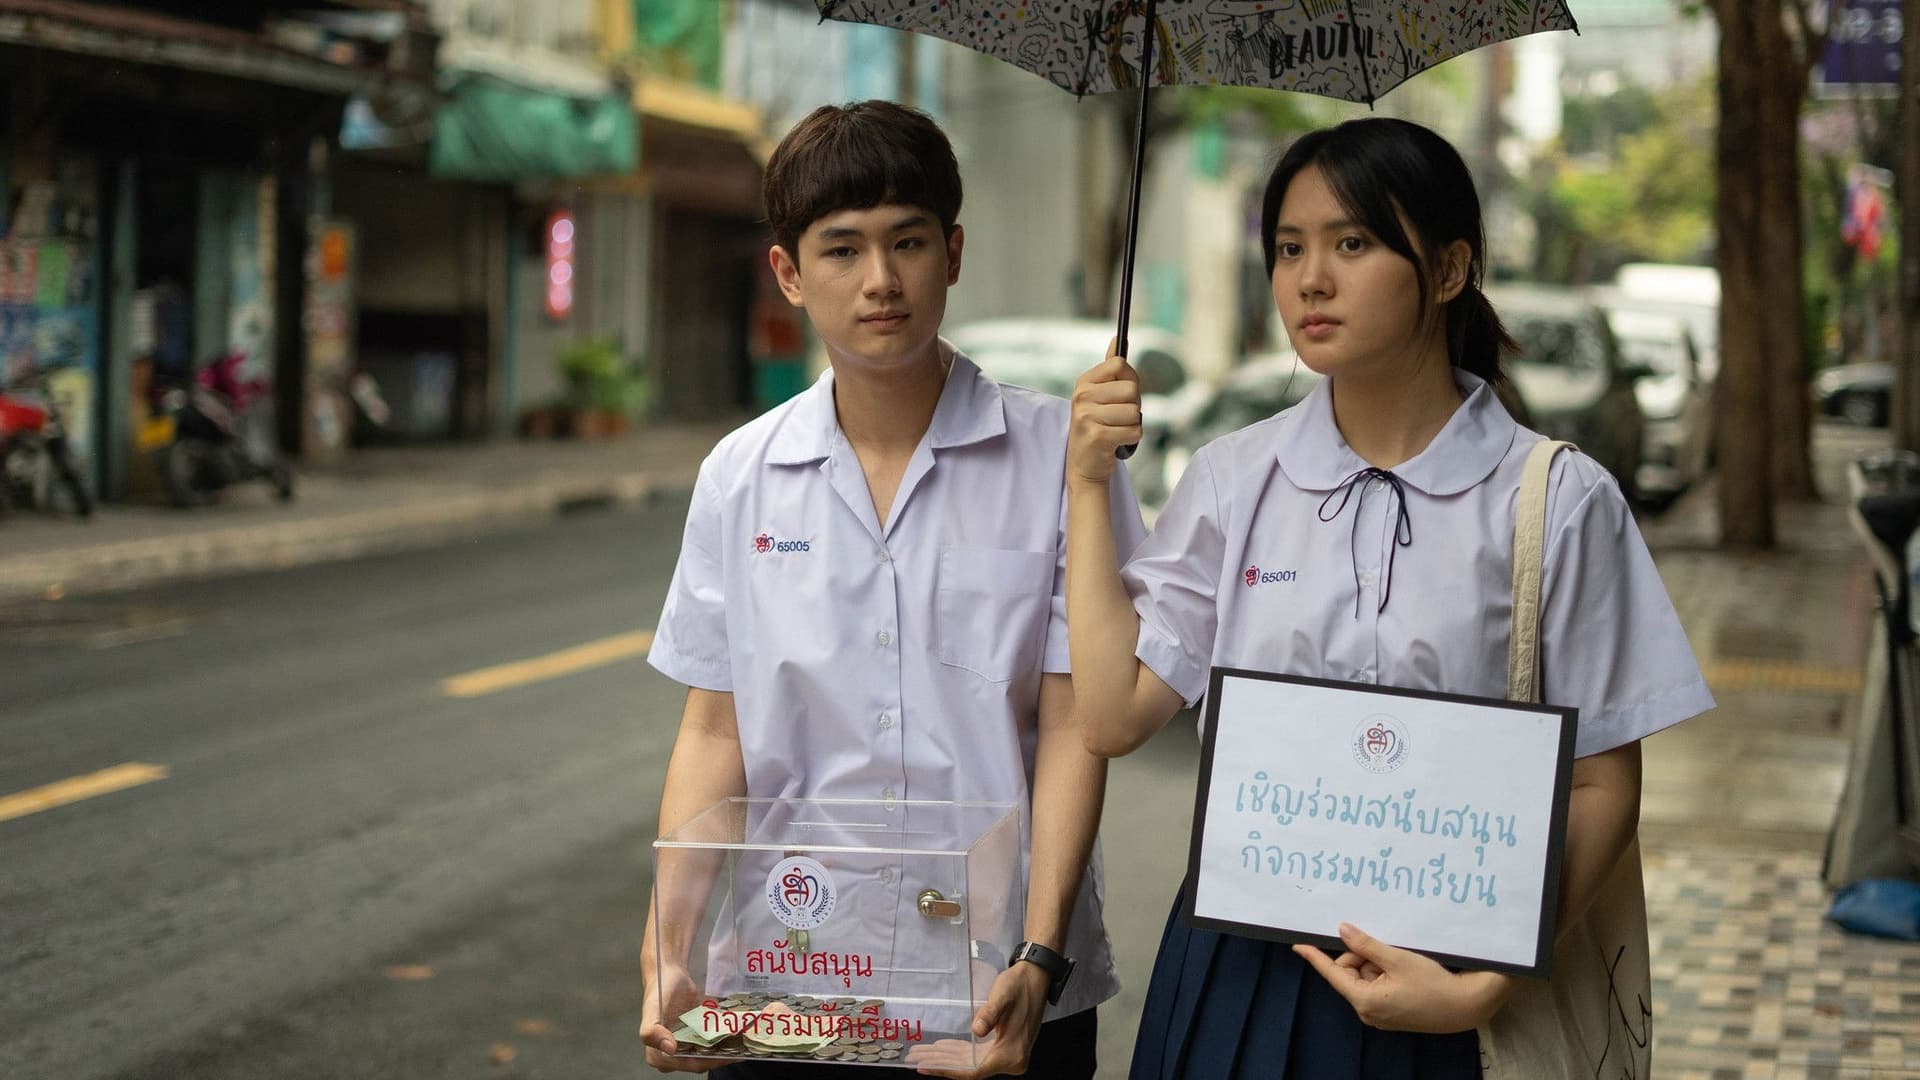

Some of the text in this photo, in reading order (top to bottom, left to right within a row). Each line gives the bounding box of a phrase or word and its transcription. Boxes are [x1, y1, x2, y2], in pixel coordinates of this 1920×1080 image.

[777, 541, 810, 552] 65005
[1261, 570, 1296, 583] 65001
[1235, 771, 1517, 867] เชิญร่วมสนับสนุน
[1241, 831, 1497, 907] กิจกรรมนักเรียน
[746, 939, 873, 988] สนับสนุน
[702, 999, 923, 1042] กิจกรรมนักเรียน
